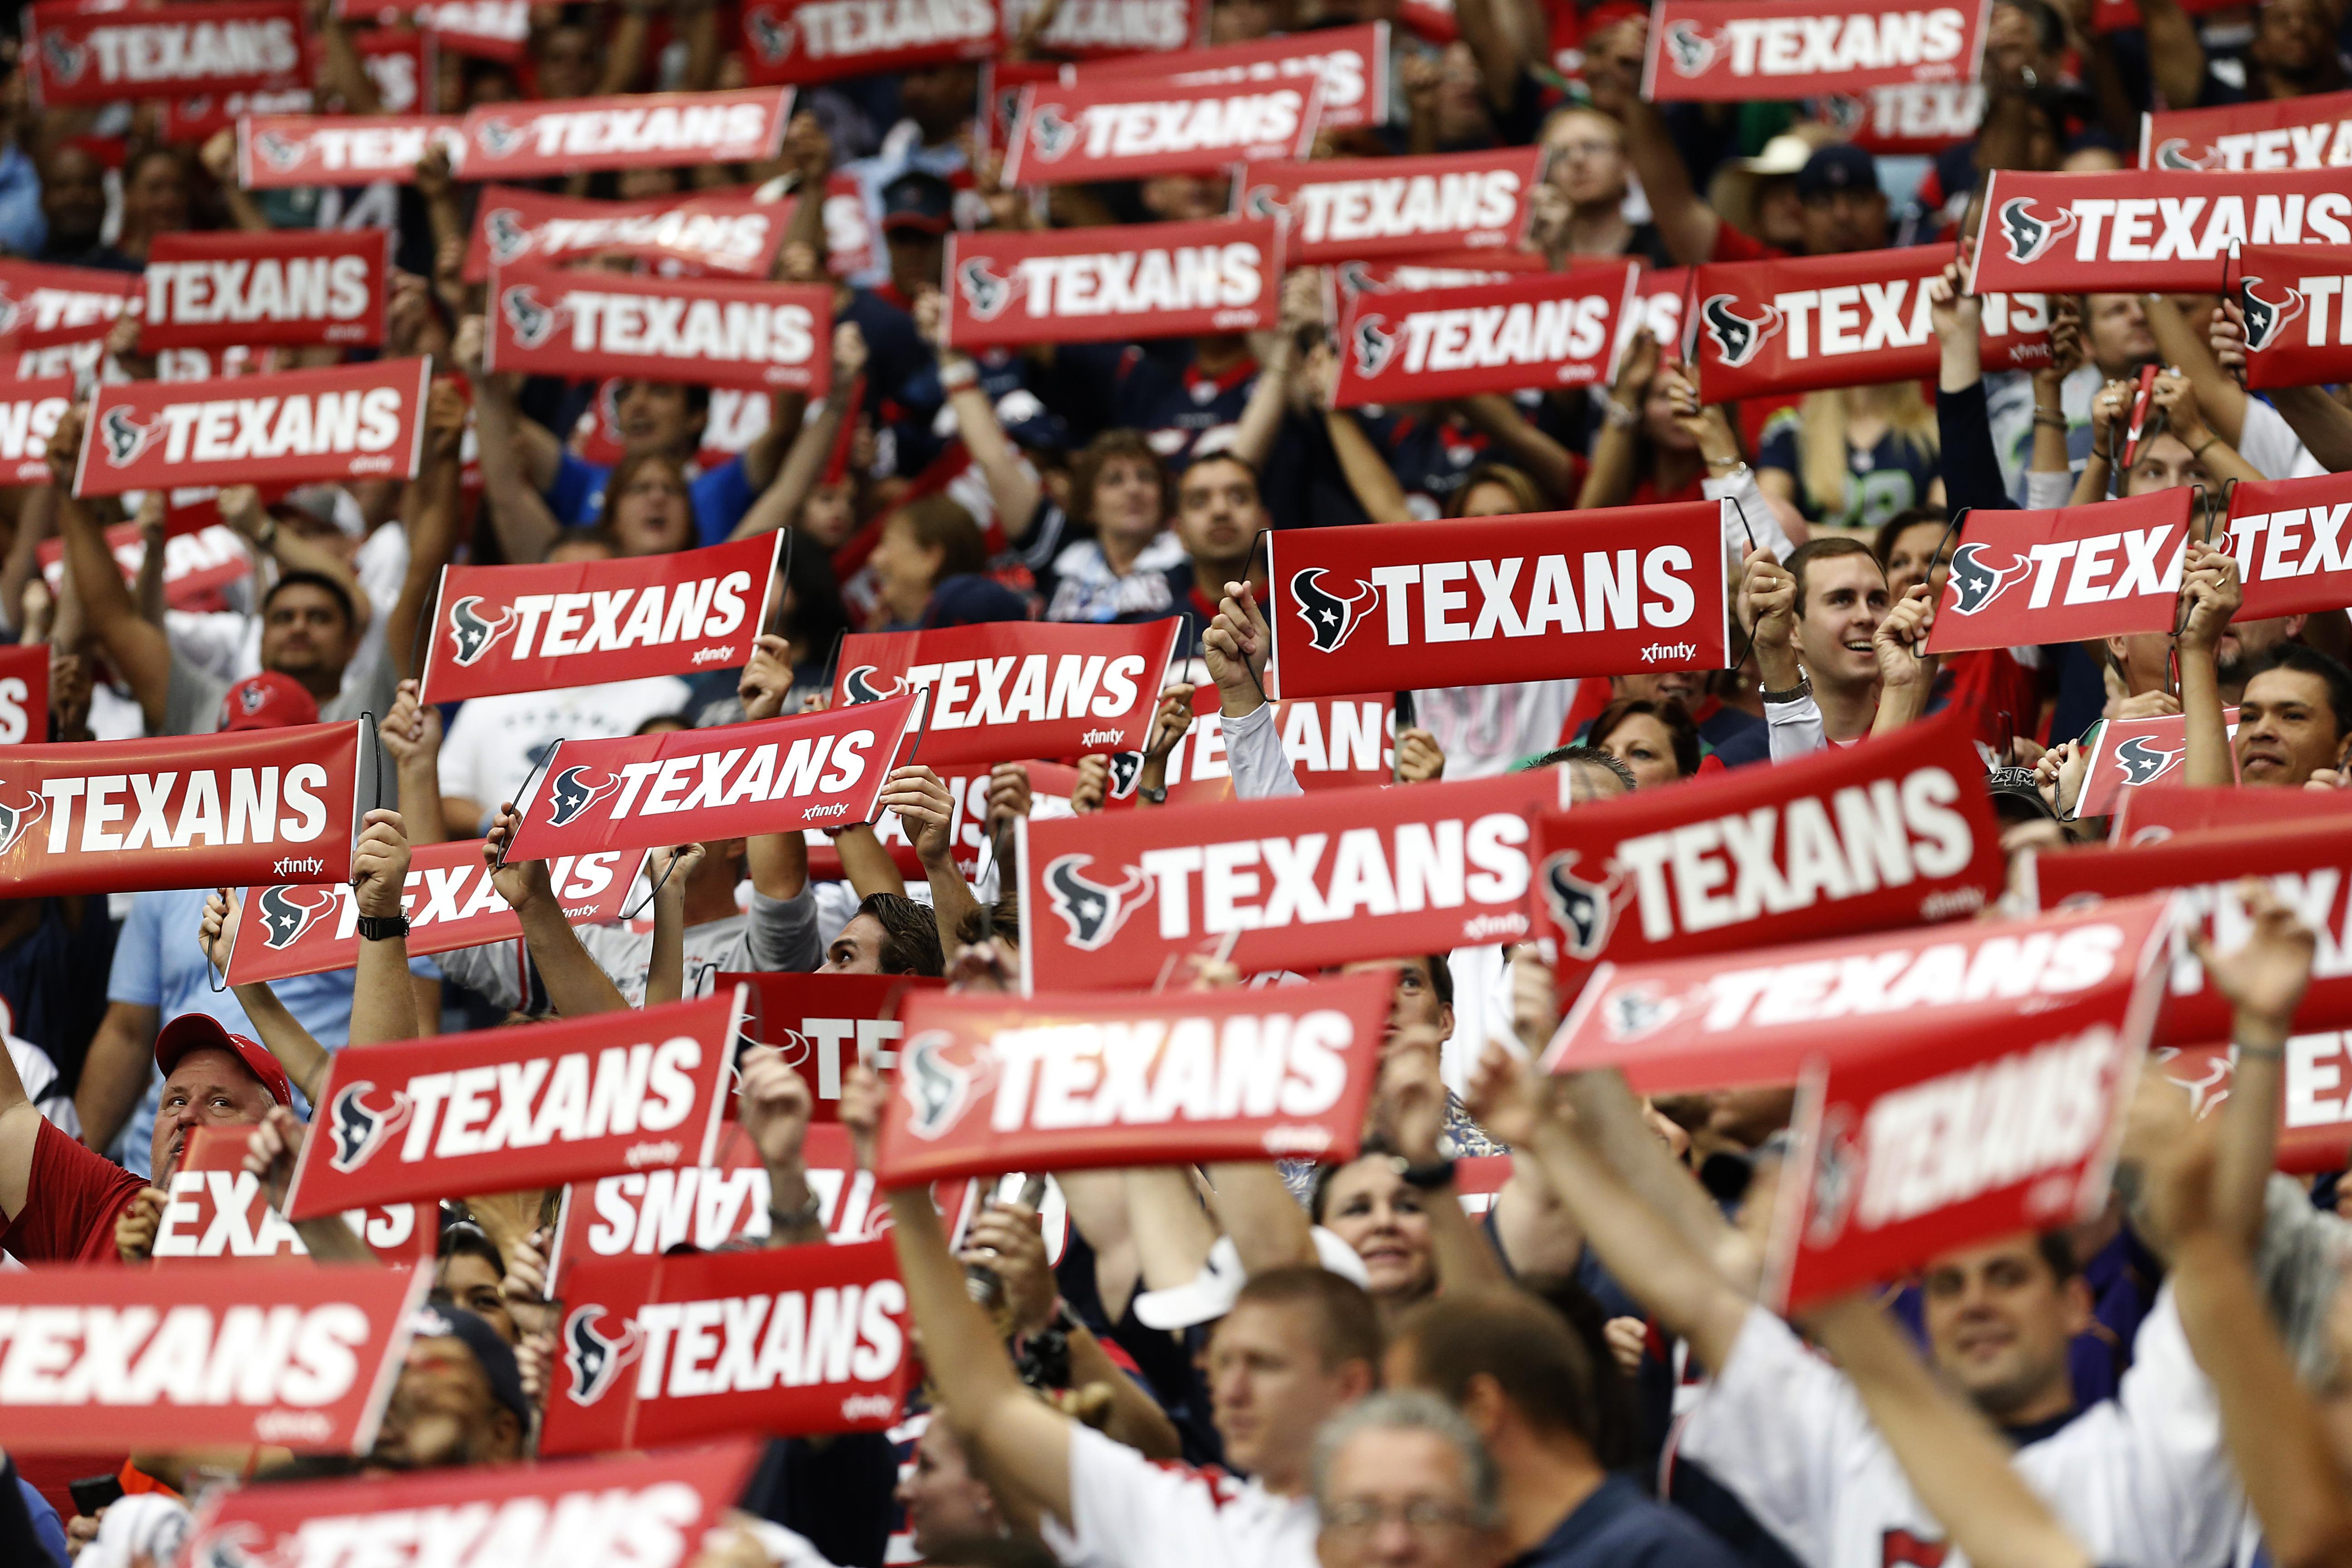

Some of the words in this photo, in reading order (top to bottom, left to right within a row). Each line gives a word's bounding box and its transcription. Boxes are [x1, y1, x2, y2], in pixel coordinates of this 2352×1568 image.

[91, 18, 299, 83] TEXANS
[1725, 6, 1966, 77] TEXANS
[533, 102, 767, 157] TEXANS
[1083, 89, 1302, 159] TEXANS
[1297, 169, 1521, 243] TEXANS
[2070, 192, 2352, 262] TEXANS
[143, 253, 369, 325] TEXANS
[1016, 241, 1263, 318] TEXANS
[562, 290, 815, 364] TEXANS
[1402, 294, 1610, 374] TEXANS
[162, 387, 402, 463] TEXANS
[2027, 524, 2190, 610] TEX
[2229, 501, 2352, 584] TEX
[511, 570, 751, 661] TEXANS
[1371, 544, 1695, 646] TEXANS
[906, 653, 1146, 732] TEXANS
[609, 729, 876, 820] TEXANS
[1164, 700, 1396, 787] TEAN
[42, 762, 328, 855] TEXANS
[1140, 812, 1532, 939] TEXANS
[1616, 766, 1974, 943] TEXANS
[1704, 926, 2122, 1033] TEXANS
[401, 1035, 702, 1163] TEXANS
[990, 1008, 1354, 1133] TEXANS
[636, 1279, 906, 1401] TEXANS
